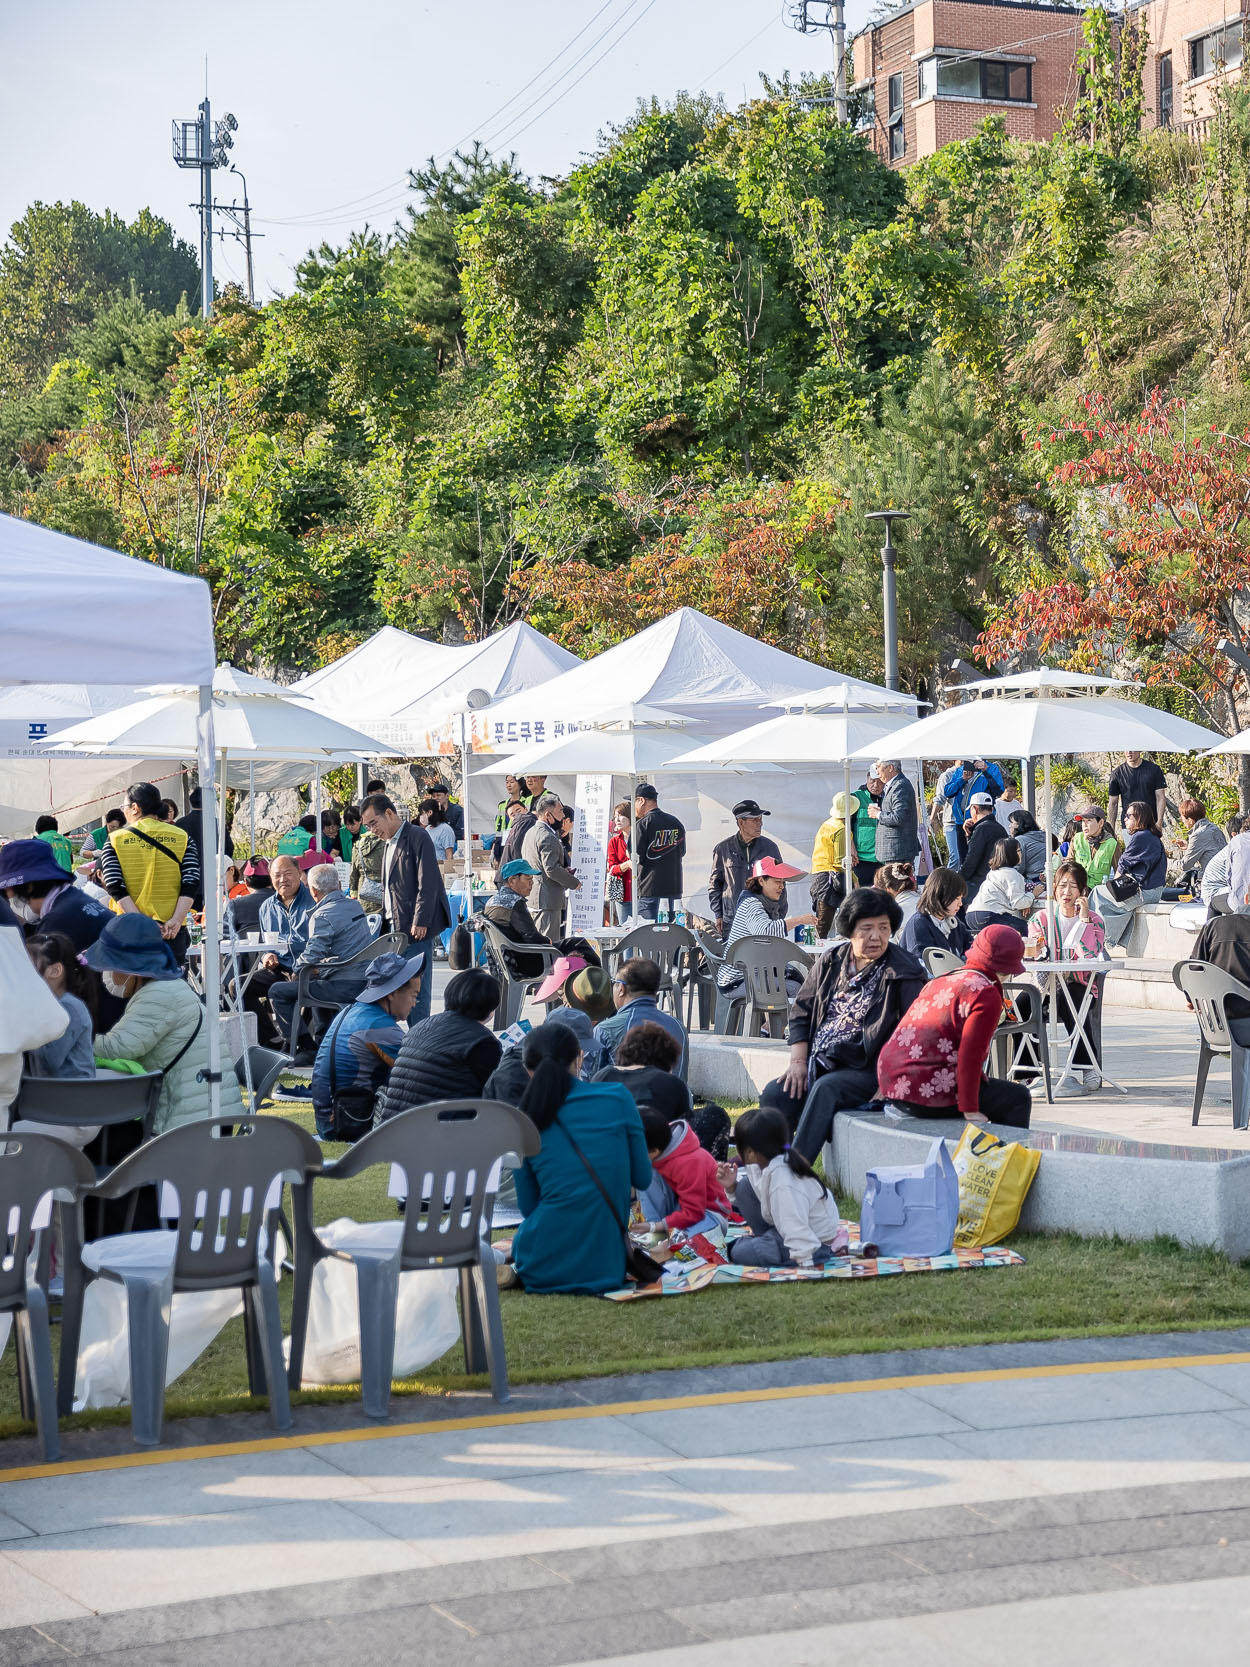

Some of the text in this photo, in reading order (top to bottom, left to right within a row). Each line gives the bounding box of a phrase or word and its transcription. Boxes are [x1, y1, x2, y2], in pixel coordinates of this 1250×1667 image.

[495, 721, 545, 743] 푸드쿠폰
[653, 829, 679, 847] NIKE
[966, 1171, 994, 1188] CLEAN
[973, 1165, 997, 1179] LOVE
